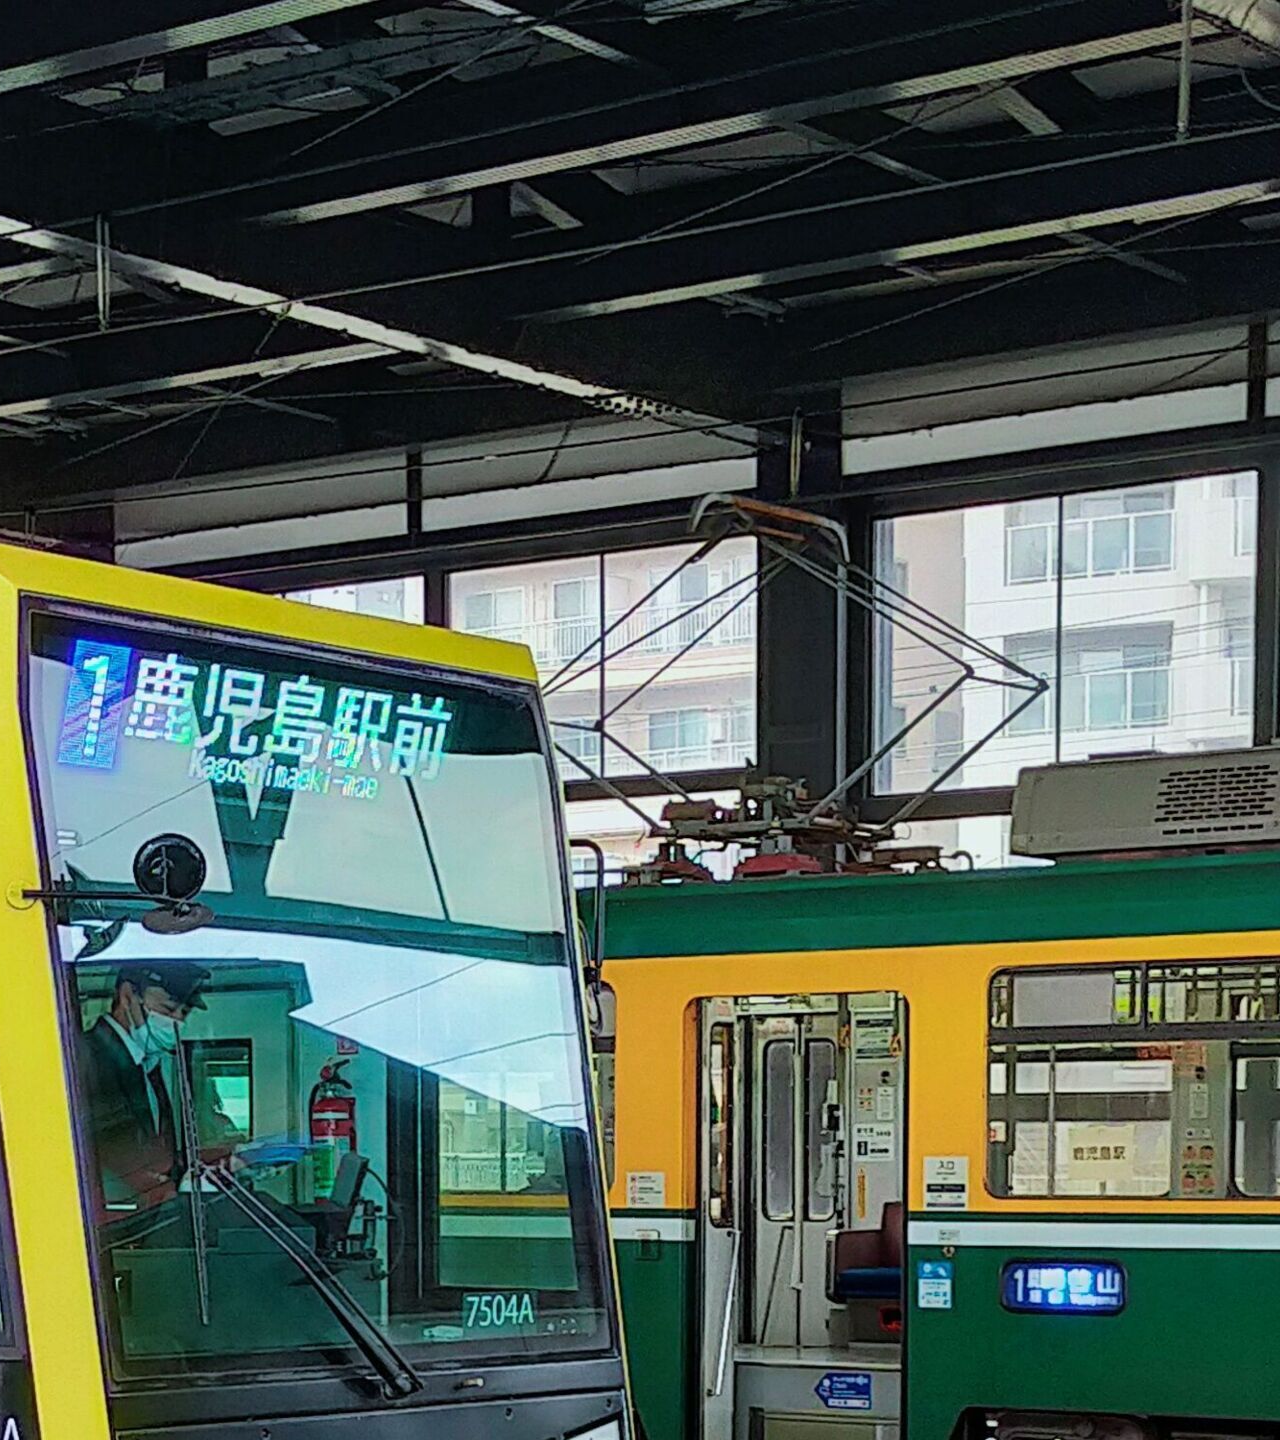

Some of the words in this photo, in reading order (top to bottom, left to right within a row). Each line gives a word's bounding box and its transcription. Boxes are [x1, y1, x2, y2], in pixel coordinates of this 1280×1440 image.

[80, 653, 110, 759] 1
[124, 652, 452, 780] 鹿児島駅前
[465, 1293, 535, 1329] 7504A
[1014, 1268, 1024, 1303] 1
